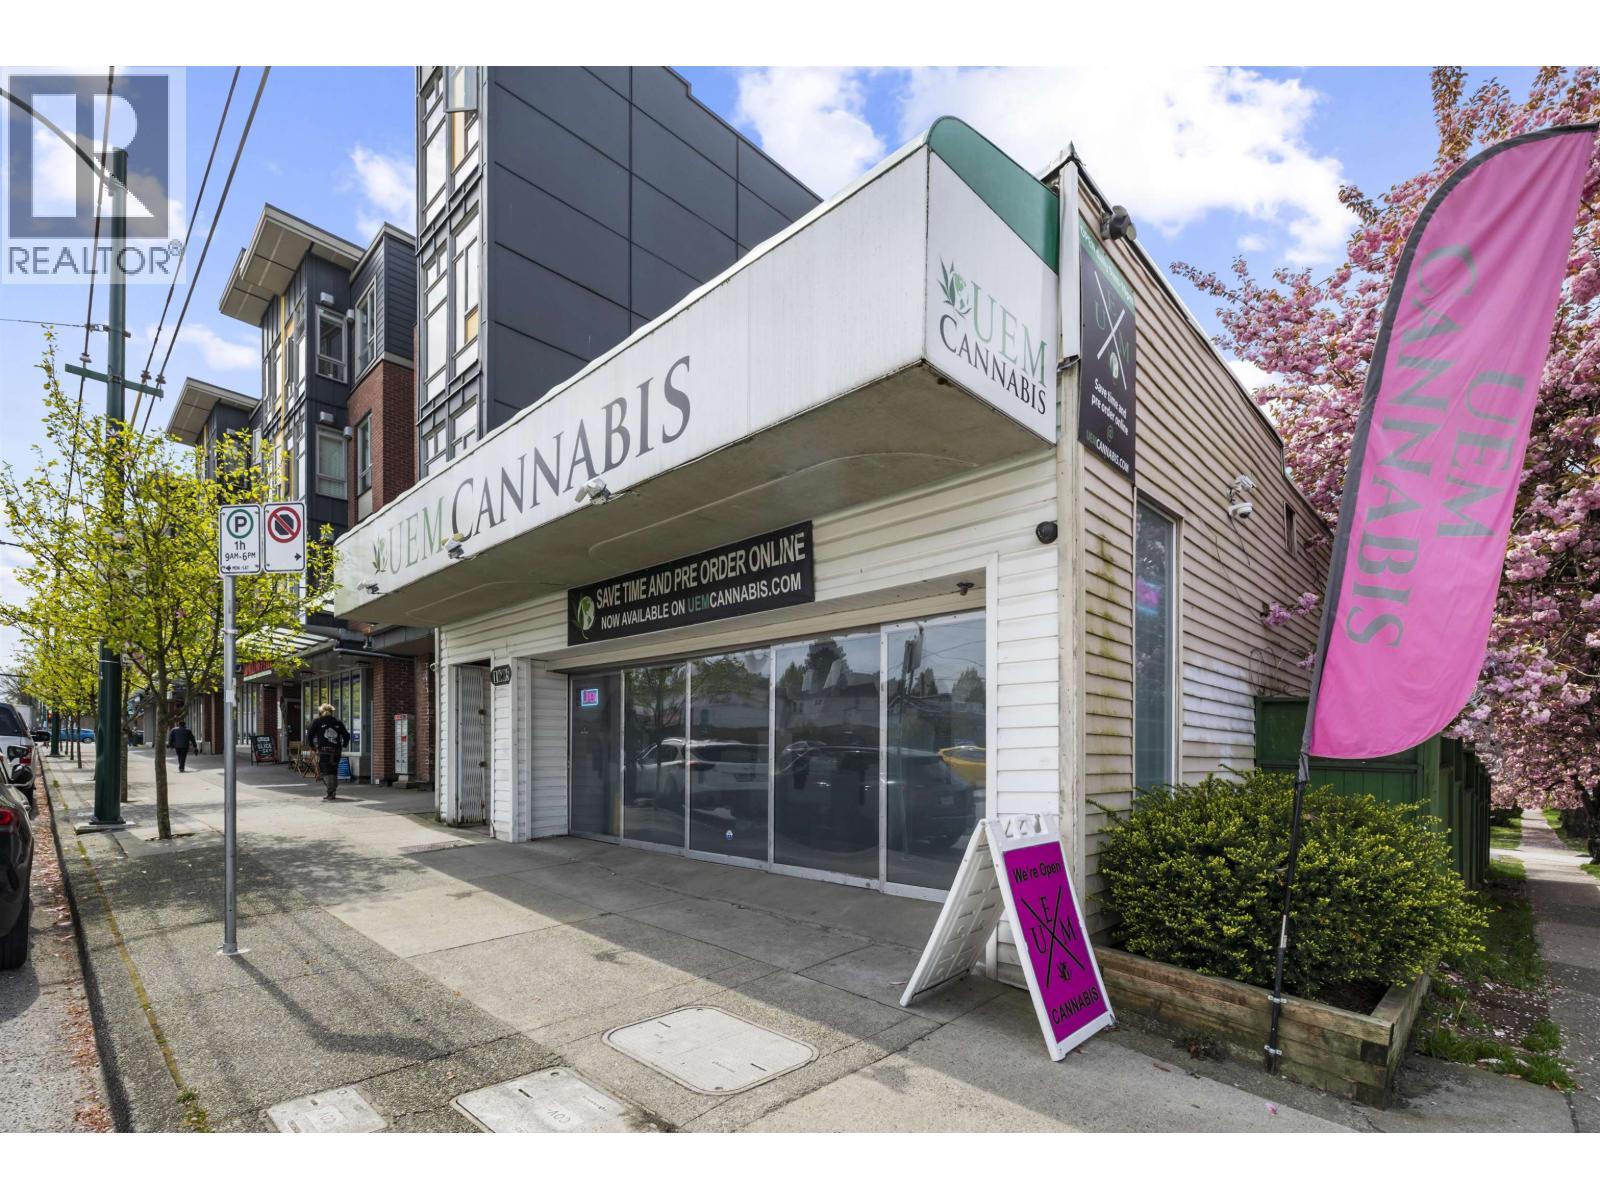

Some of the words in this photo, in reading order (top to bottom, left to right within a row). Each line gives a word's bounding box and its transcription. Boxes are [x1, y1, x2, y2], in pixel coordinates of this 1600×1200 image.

[971, 281, 1047, 388] UEM
[940, 314, 1046, 415] CANNABIS
[1091, 394, 1101, 409] pre
[1101, 401, 1115, 421] order
[1115, 416, 1129, 436] online
[1094, 378, 1107, 399] Save
[1107, 391, 1119, 410] time
[1118, 402, 1127, 419] and
[389, 496, 445, 575] UEM
[452, 356, 691, 542] CANNABIS
[1346, 243, 1477, 648] CANNABIS
[1436, 370, 1526, 538] UEM
[234, 515, 247, 533] P
[234, 540, 246, 551] 1h
[596, 587, 620, 609] SAVE
[622, 578, 647, 603] TIME
[648, 571, 672, 597] AND
[674, 564, 697, 592] PRE
[700, 553, 746, 585] ORDER
[749, 533, 806, 572] ONLINE
[601, 613, 620, 631] NOW
[622, 603, 669, 626] AVAILABLE
[671, 600, 685, 616] ON
[687, 572, 801, 613] UEMCANNABIS.COM
[1013, 866, 1038, 884] We're
[1040, 861, 1062, 879] Open
[1052, 986, 1100, 1025] CANNABIS
